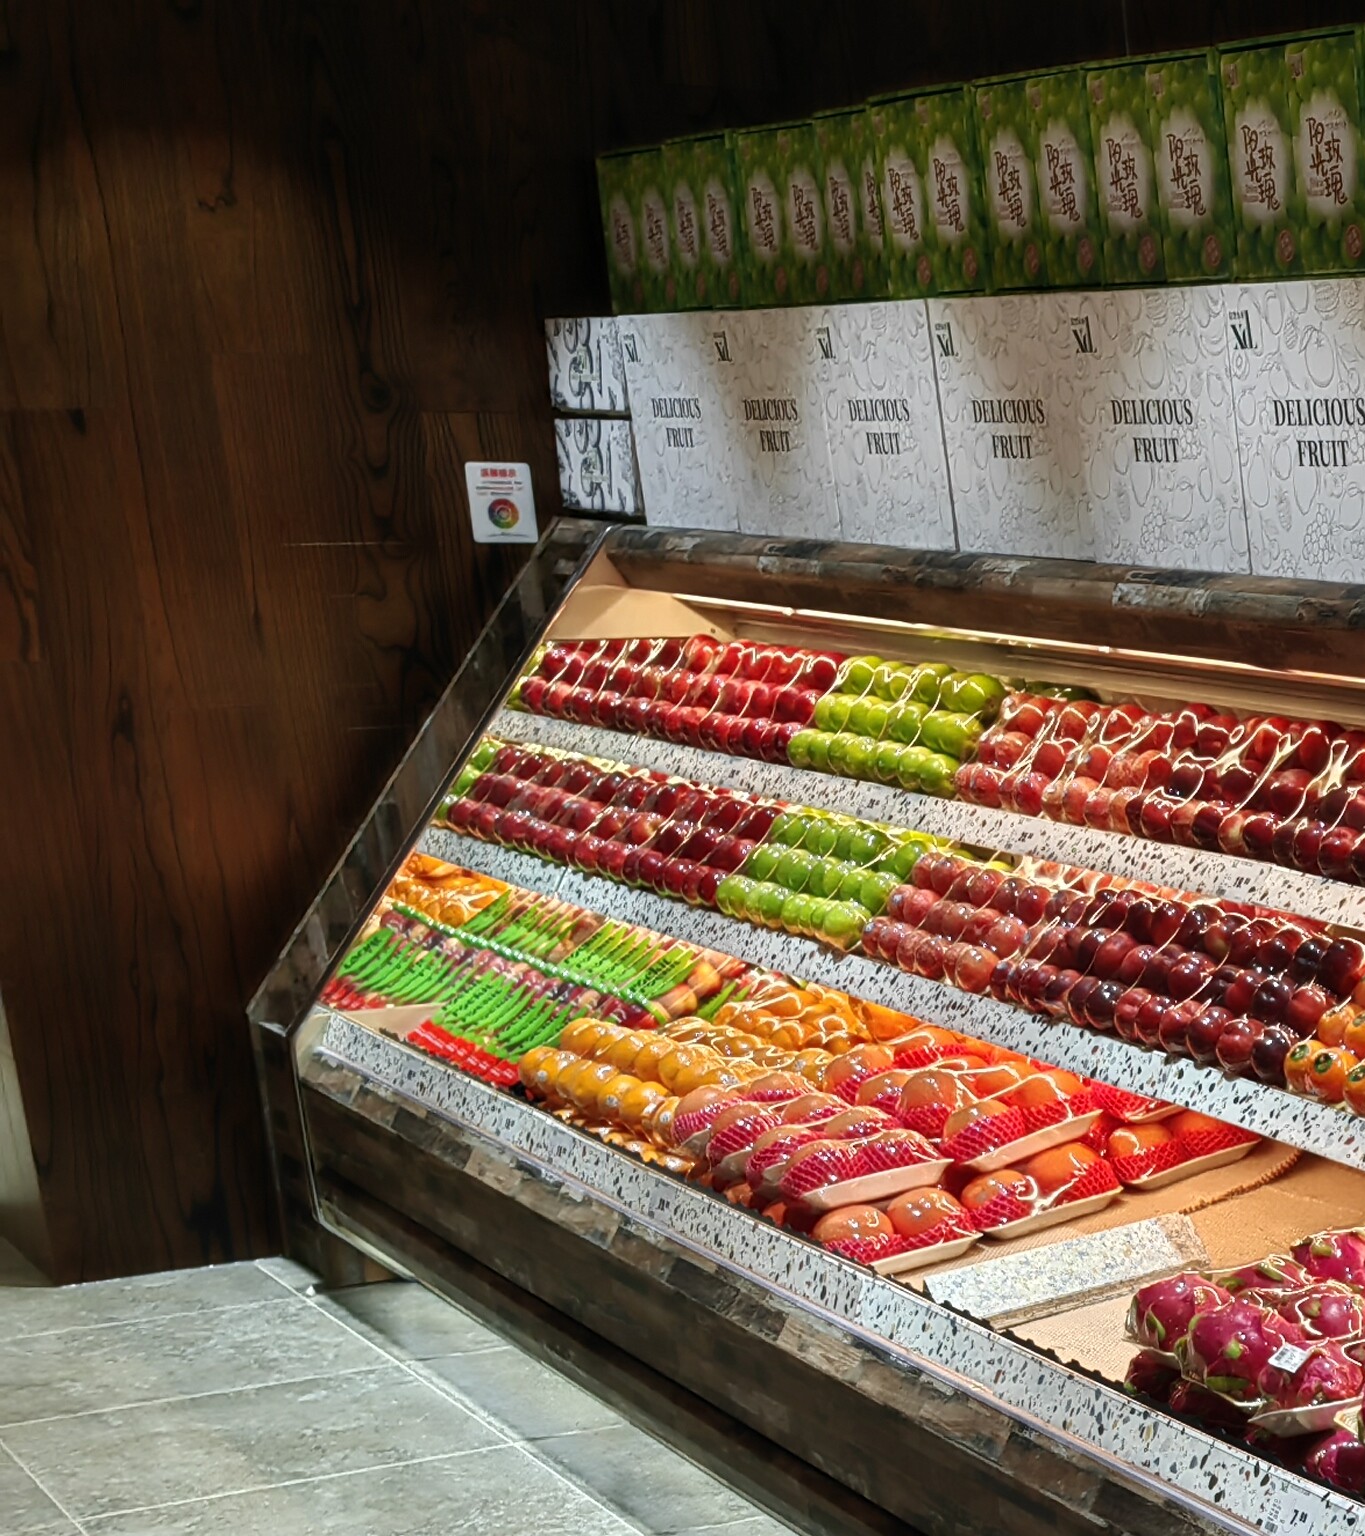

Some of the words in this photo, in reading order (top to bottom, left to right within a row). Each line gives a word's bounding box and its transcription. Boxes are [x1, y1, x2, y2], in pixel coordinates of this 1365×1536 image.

[651, 397, 701, 420] DELICIOUS
[743, 398, 798, 421] DELICIOUS
[848, 398, 900, 422] DELICIOUS
[972, 399, 1046, 424] DELICIOUS
[1111, 399, 1193, 425] DELICIOUS
[665, 426, 696, 449] FRUIT
[759, 430, 791, 452] FRUIT
[865, 431, 902, 454] FRUIT
[992, 434, 1033, 459] FRUIT
[1133, 437, 1179, 463] FRUIT
[1296, 440, 1350, 467] FRUIT
